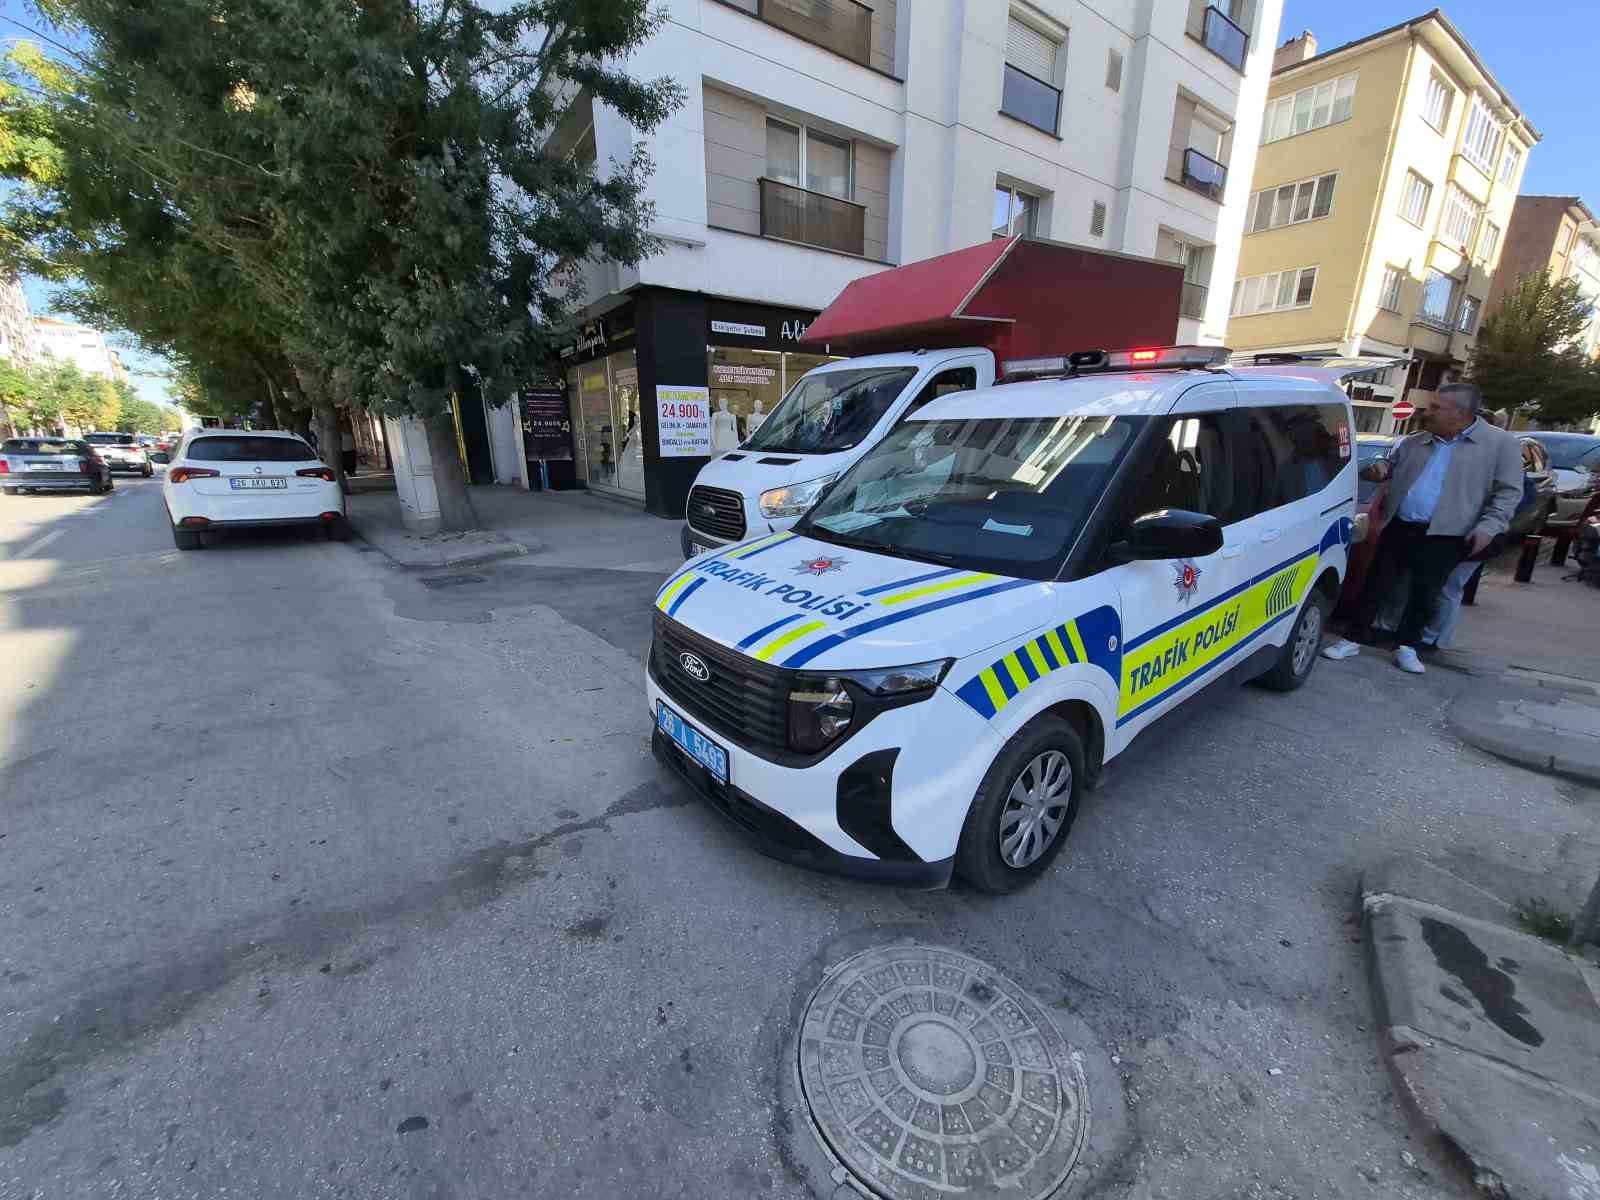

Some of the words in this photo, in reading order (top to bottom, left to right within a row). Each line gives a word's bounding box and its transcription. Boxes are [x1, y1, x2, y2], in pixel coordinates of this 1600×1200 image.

[781, 319, 808, 344] Alt
[661, 403, 699, 418] 24.900
[698, 560, 777, 591] TRAFİK
[764, 584, 872, 621] POLİSİ
[1130, 638, 1190, 696] TRAFİK
[1193, 604, 1240, 656] POLİSİ
[684, 655, 703, 677] Ford
